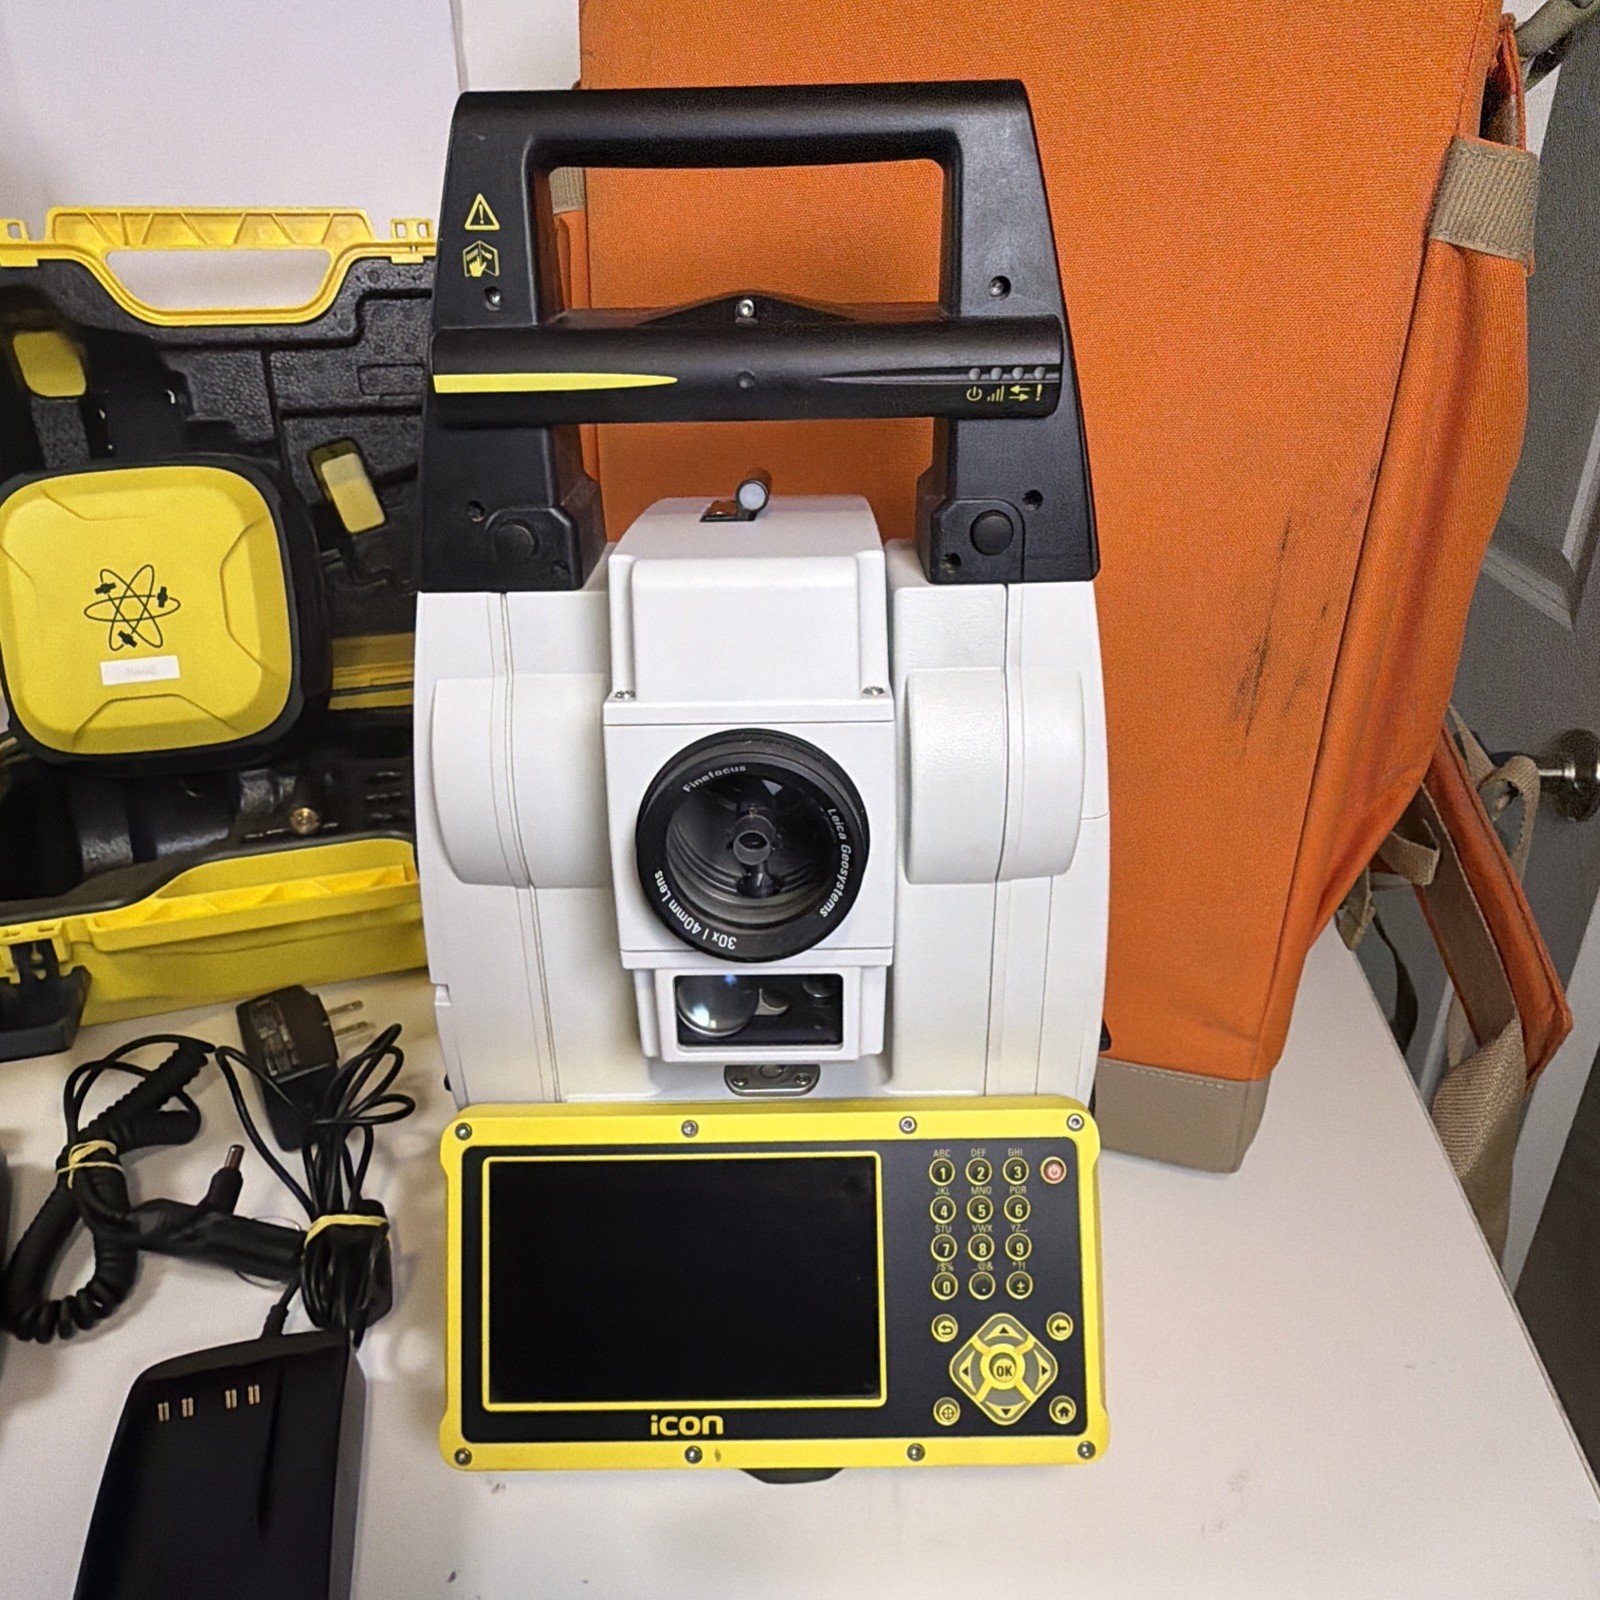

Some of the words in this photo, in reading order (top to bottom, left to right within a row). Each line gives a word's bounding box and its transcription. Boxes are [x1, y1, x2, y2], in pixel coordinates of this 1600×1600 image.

[682, 765, 747, 792] Finefocus
[827, 808, 847, 840] Leica
[654, 870, 672, 902] Lens
[820, 844, 852, 917] Geosystems
[668, 899, 702, 934] 40mm
[711, 931, 738, 950] 30x
[933, 1148, 951, 1158] ABC
[970, 1148, 986, 1157] DEF
[1007, 1148, 1023, 1157] GHI
[939, 1167, 946, 1180] 1
[976, 1166, 985, 1180] 2
[1013, 1165, 1022, 1179] 3
[935, 1187, 950, 1195] JKL
[970, 1185, 992, 1195] MNO
[940, 1205, 948, 1218] 4
[978, 1204, 986, 1217] 5
[1014, 1204, 1023, 1217] 6
[934, 1224, 952, 1233] STU
[971, 1224, 993, 1233] VWX
[942, 1243, 949, 1256] 7
[978, 1243, 987, 1256] 8
[1015, 1242, 1024, 1255] 9
[942, 1281, 951, 1294] 0
[995, 1366, 1013, 1378] OK
